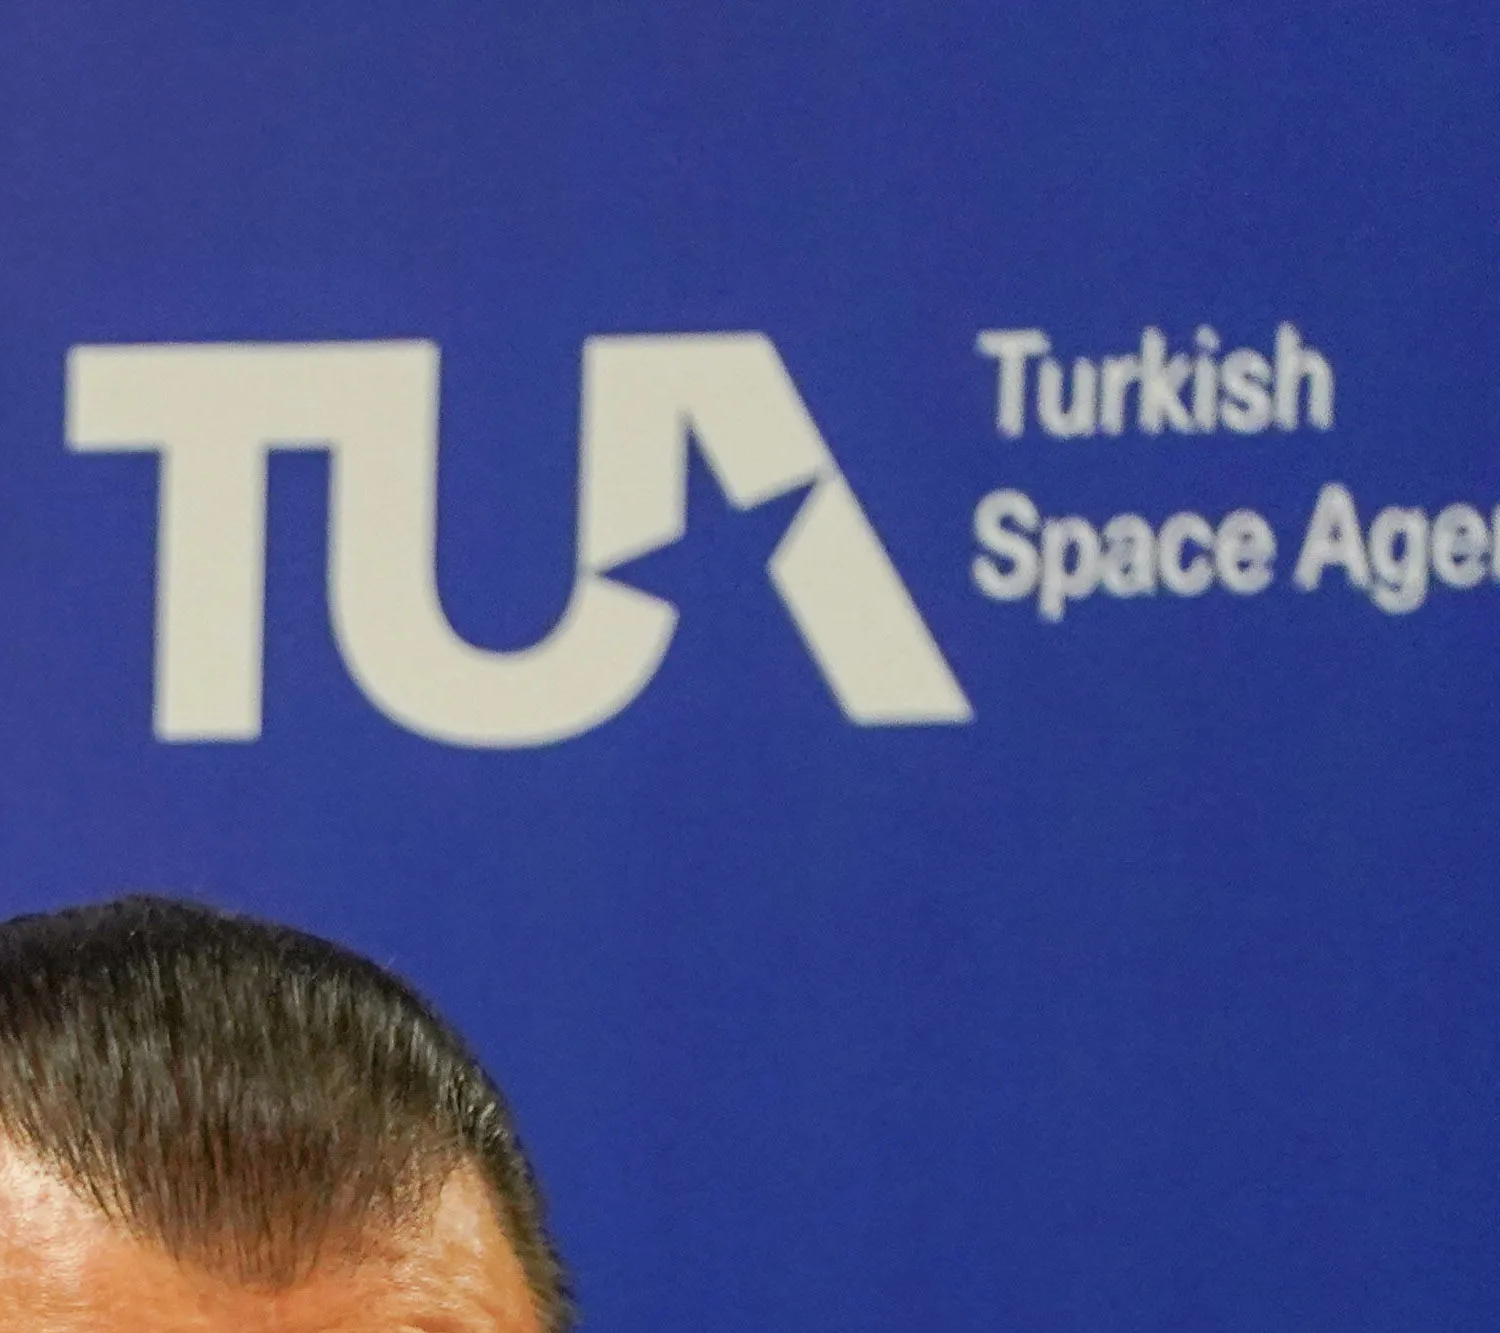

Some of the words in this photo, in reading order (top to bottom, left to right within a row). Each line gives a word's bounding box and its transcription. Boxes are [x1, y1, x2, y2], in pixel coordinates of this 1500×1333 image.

[977, 324, 1334, 438] Turkish
[64, 331, 976, 749] TUA
[972, 489, 1277, 620] Space
[1294, 483, 1500, 613] Age
